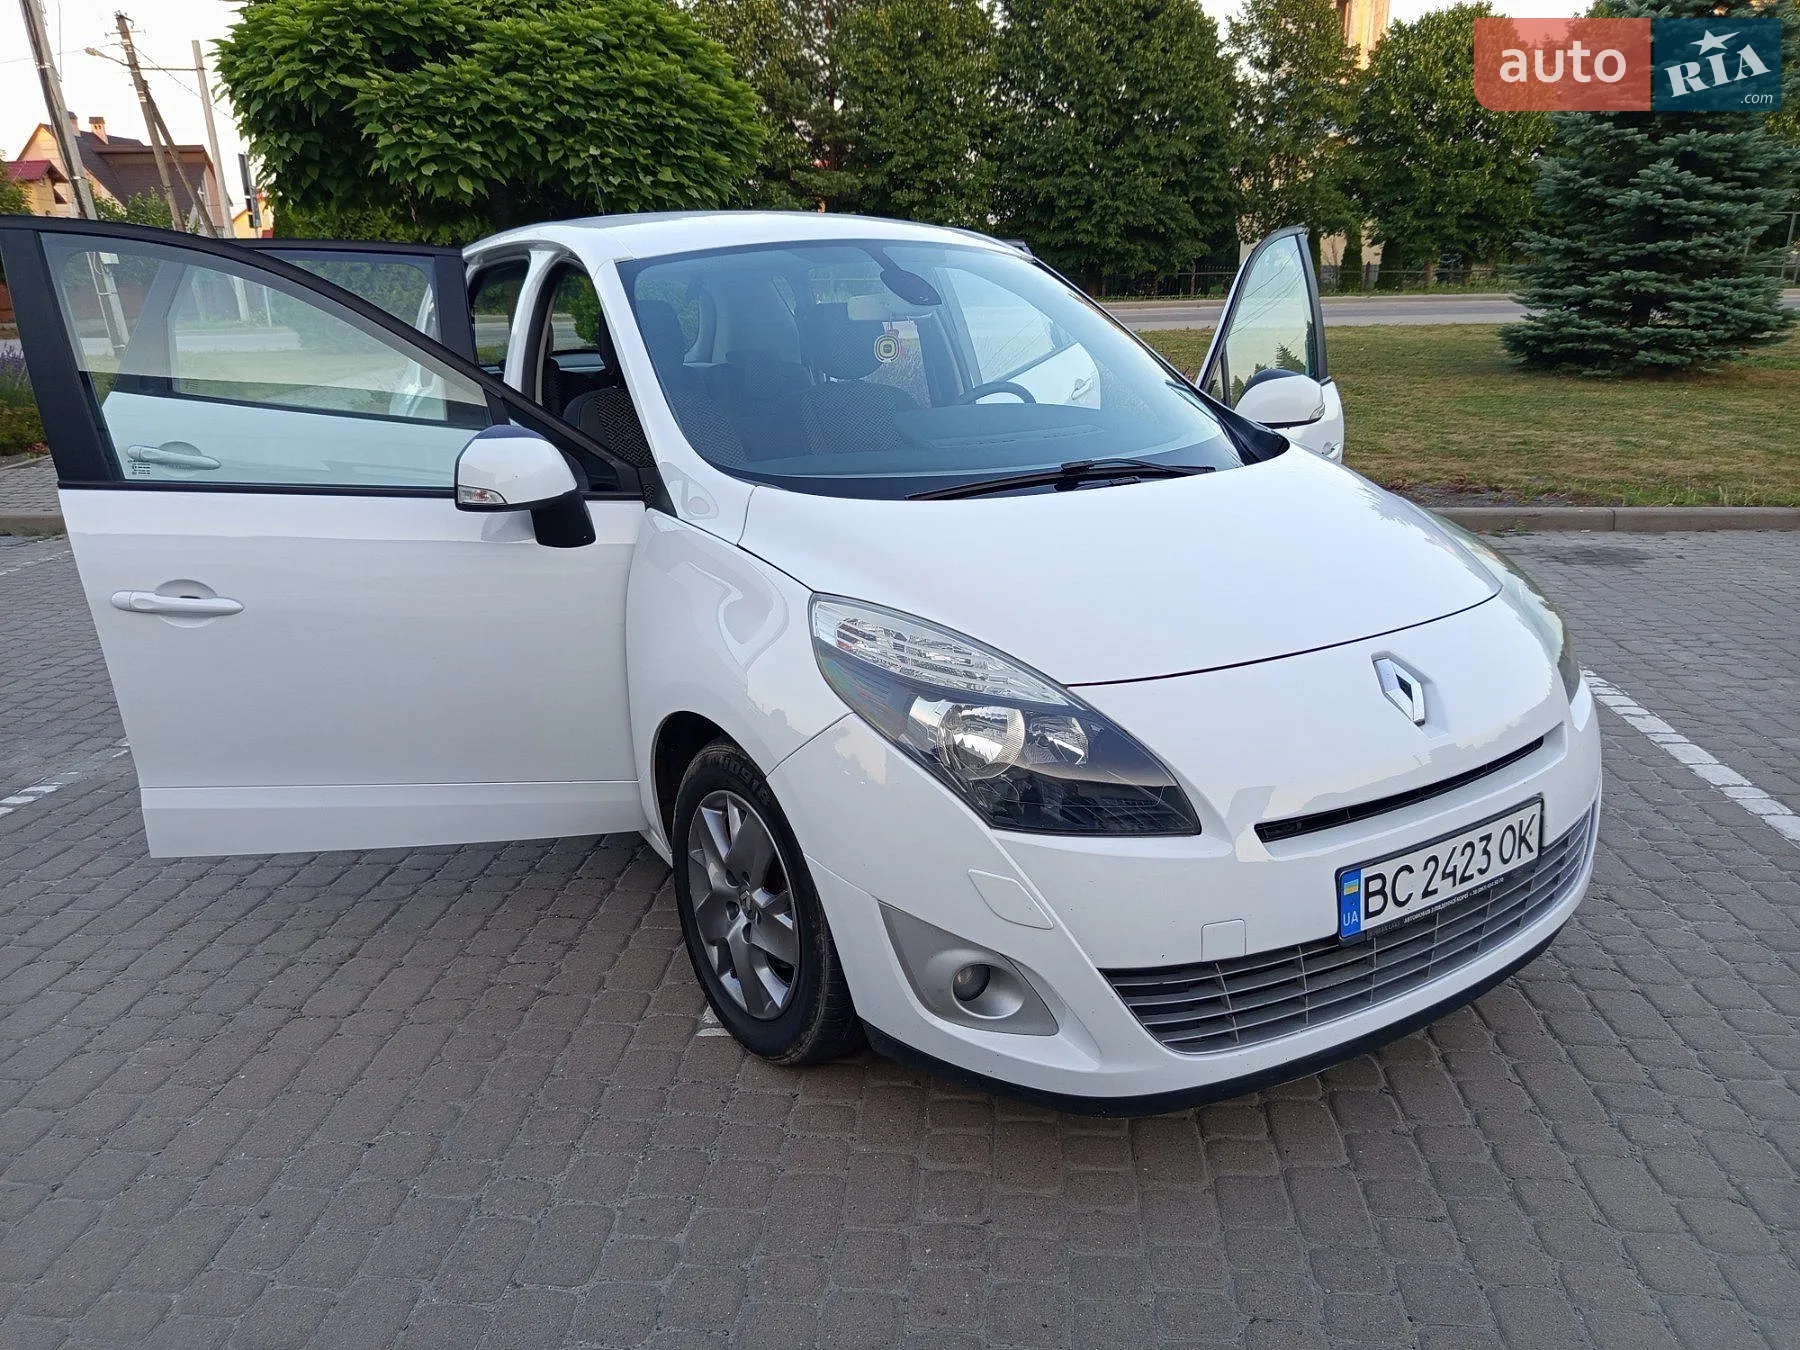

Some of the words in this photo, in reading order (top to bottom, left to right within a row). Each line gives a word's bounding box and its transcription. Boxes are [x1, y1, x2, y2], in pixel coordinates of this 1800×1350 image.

[1364, 864, 1415, 920] BC
[1421, 832, 1493, 900] 2423
[1499, 813, 1537, 865] OK
[1342, 910, 1359, 927] UA
